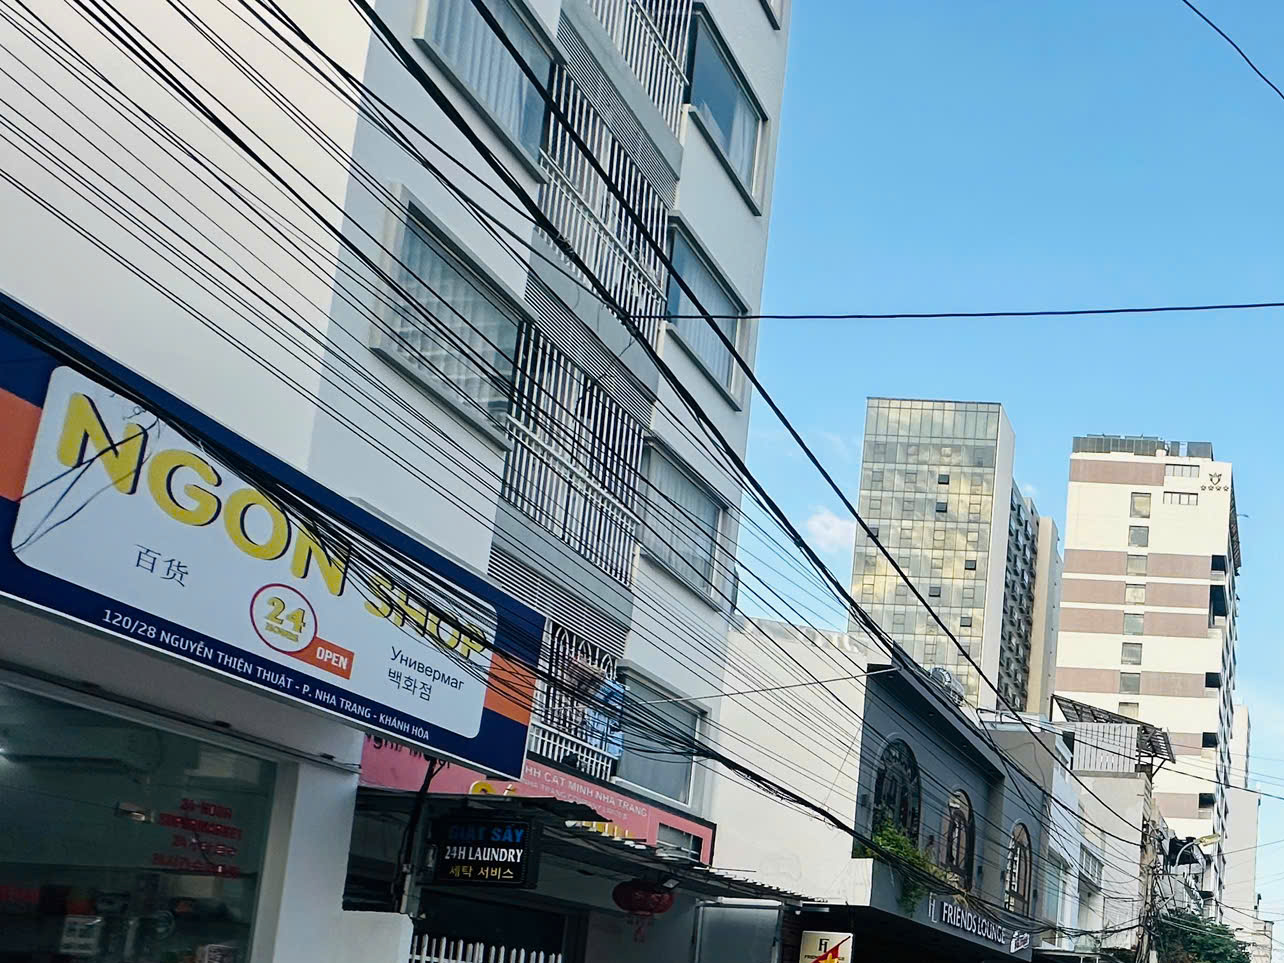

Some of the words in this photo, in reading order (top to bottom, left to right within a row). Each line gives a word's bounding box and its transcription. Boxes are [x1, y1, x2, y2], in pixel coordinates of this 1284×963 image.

[57, 391, 350, 597] NGON
[136, 543, 189, 588] 百货
[264, 596, 306, 634] 24
[102, 609, 157, 640] 120/28
[160, 630, 214, 661] NGUYỄN
[216, 650, 253, 675] THIỆN
[256, 665, 294, 689] THUẬT
[302, 684, 312, 698] P.
[315, 688, 337, 706] NHA
[339, 697, 371, 719] TRANG
[378, 711, 410, 734] KHÁNH
[315, 646, 348, 671] OPEN
[390, 645, 465, 691] Универмаг
[388, 667, 433, 702] 백화점
[617, 799, 648, 817] TRANG
[445, 846, 467, 860] 24H
[468, 847, 524, 863] LAUNDRY
[449, 865, 473, 878] 세탁
[478, 866, 514, 880] 서비스
[942, 901, 977, 934] FRIENDS
[977, 916, 1007, 945] LOUNGE
